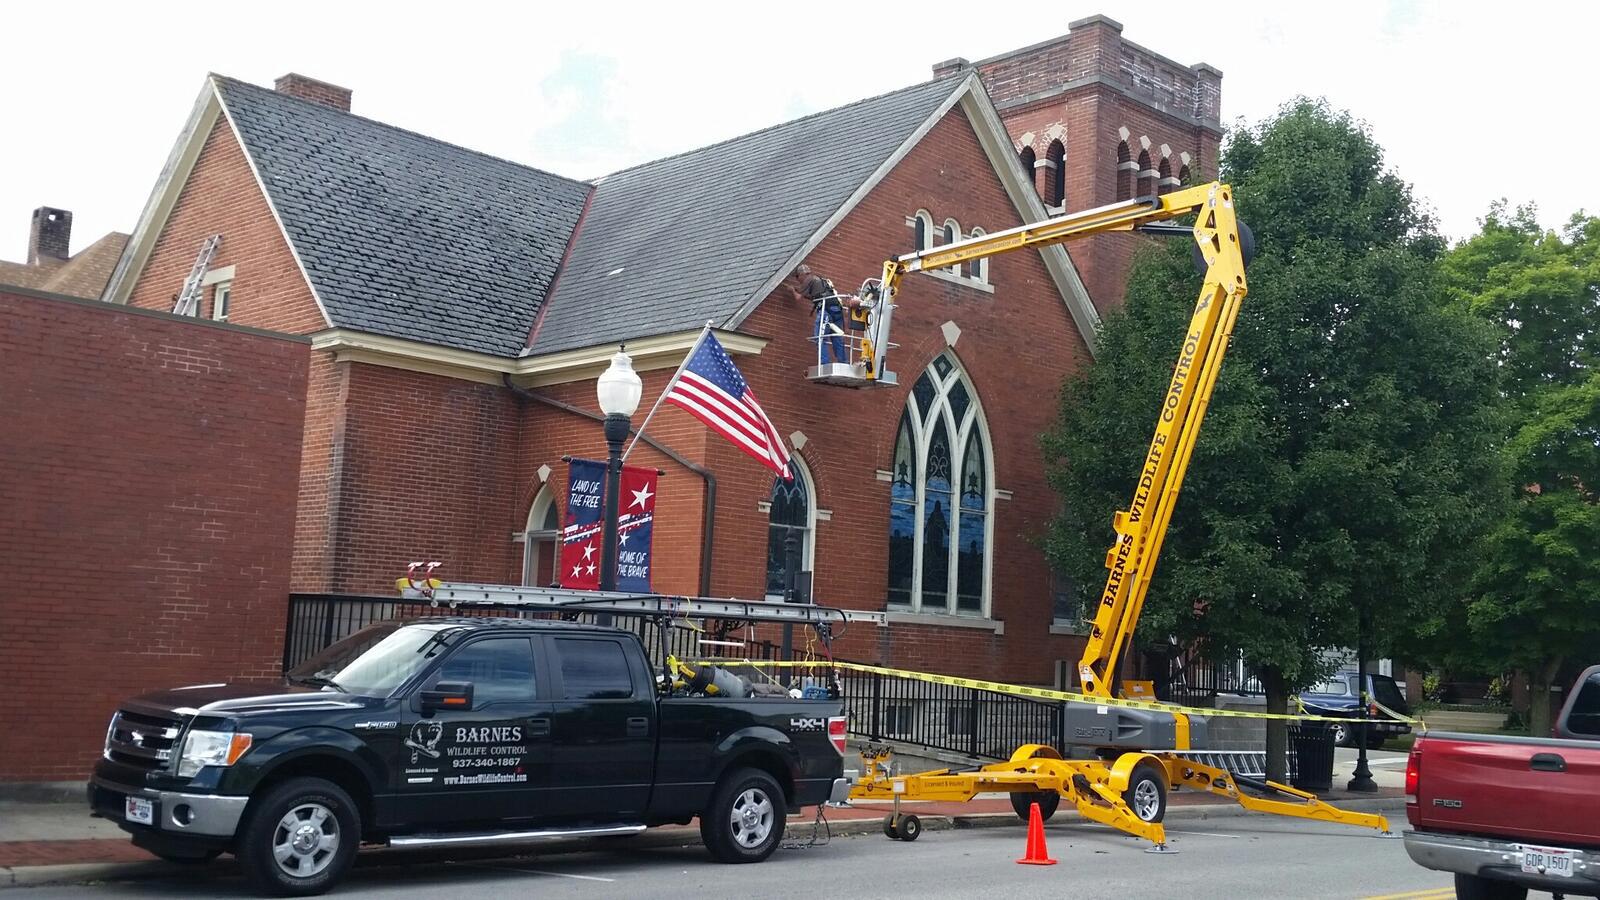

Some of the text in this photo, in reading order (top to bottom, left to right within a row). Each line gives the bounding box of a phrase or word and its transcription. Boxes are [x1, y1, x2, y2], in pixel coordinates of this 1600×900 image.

[1103, 330, 1201, 609] BARNES WILDLIFE CONTROL
[571, 479, 600, 494] LAND OF
[570, 493, 600, 508] THE FREE
[619, 550, 647, 565] HOME OF
[617, 564, 648, 578] THE BRAVE
[456, 727, 522, 743] BARNES
[447, 746, 528, 756] WILDLIFE CONTROL
[452, 758, 521, 768] 937-340-1867
[1525, 853, 1569, 870] GDR 1507
